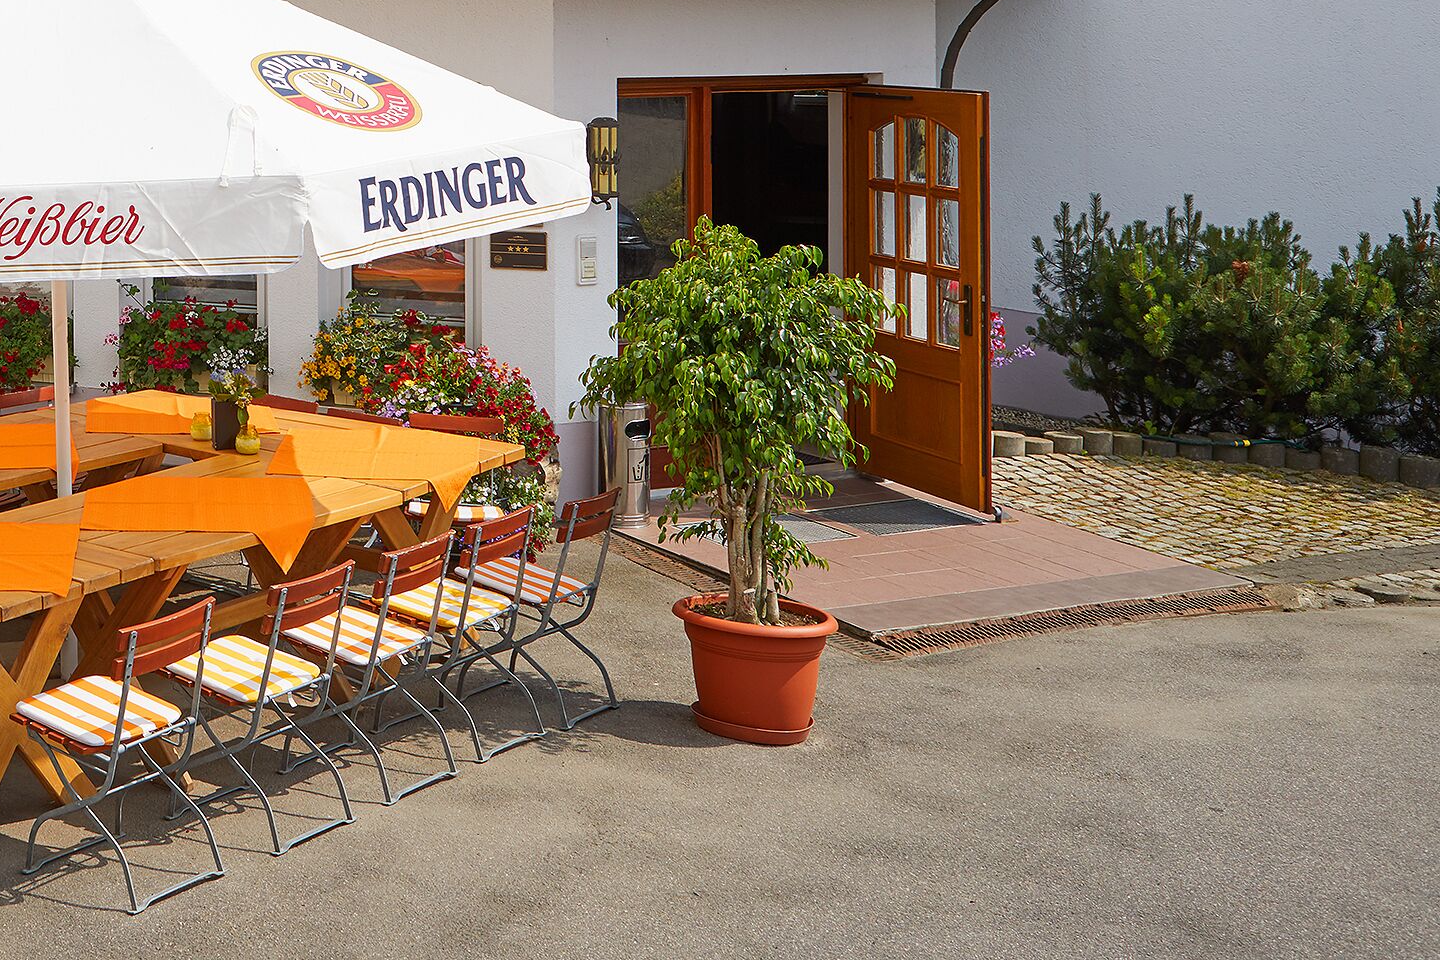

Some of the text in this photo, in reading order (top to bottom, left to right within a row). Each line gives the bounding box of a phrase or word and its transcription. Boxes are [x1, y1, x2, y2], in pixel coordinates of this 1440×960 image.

[261, 54, 369, 91] ERDINGER
[315, 94, 410, 127] WEISSBRÄU
[358, 156, 537, 233] ERDINGER
